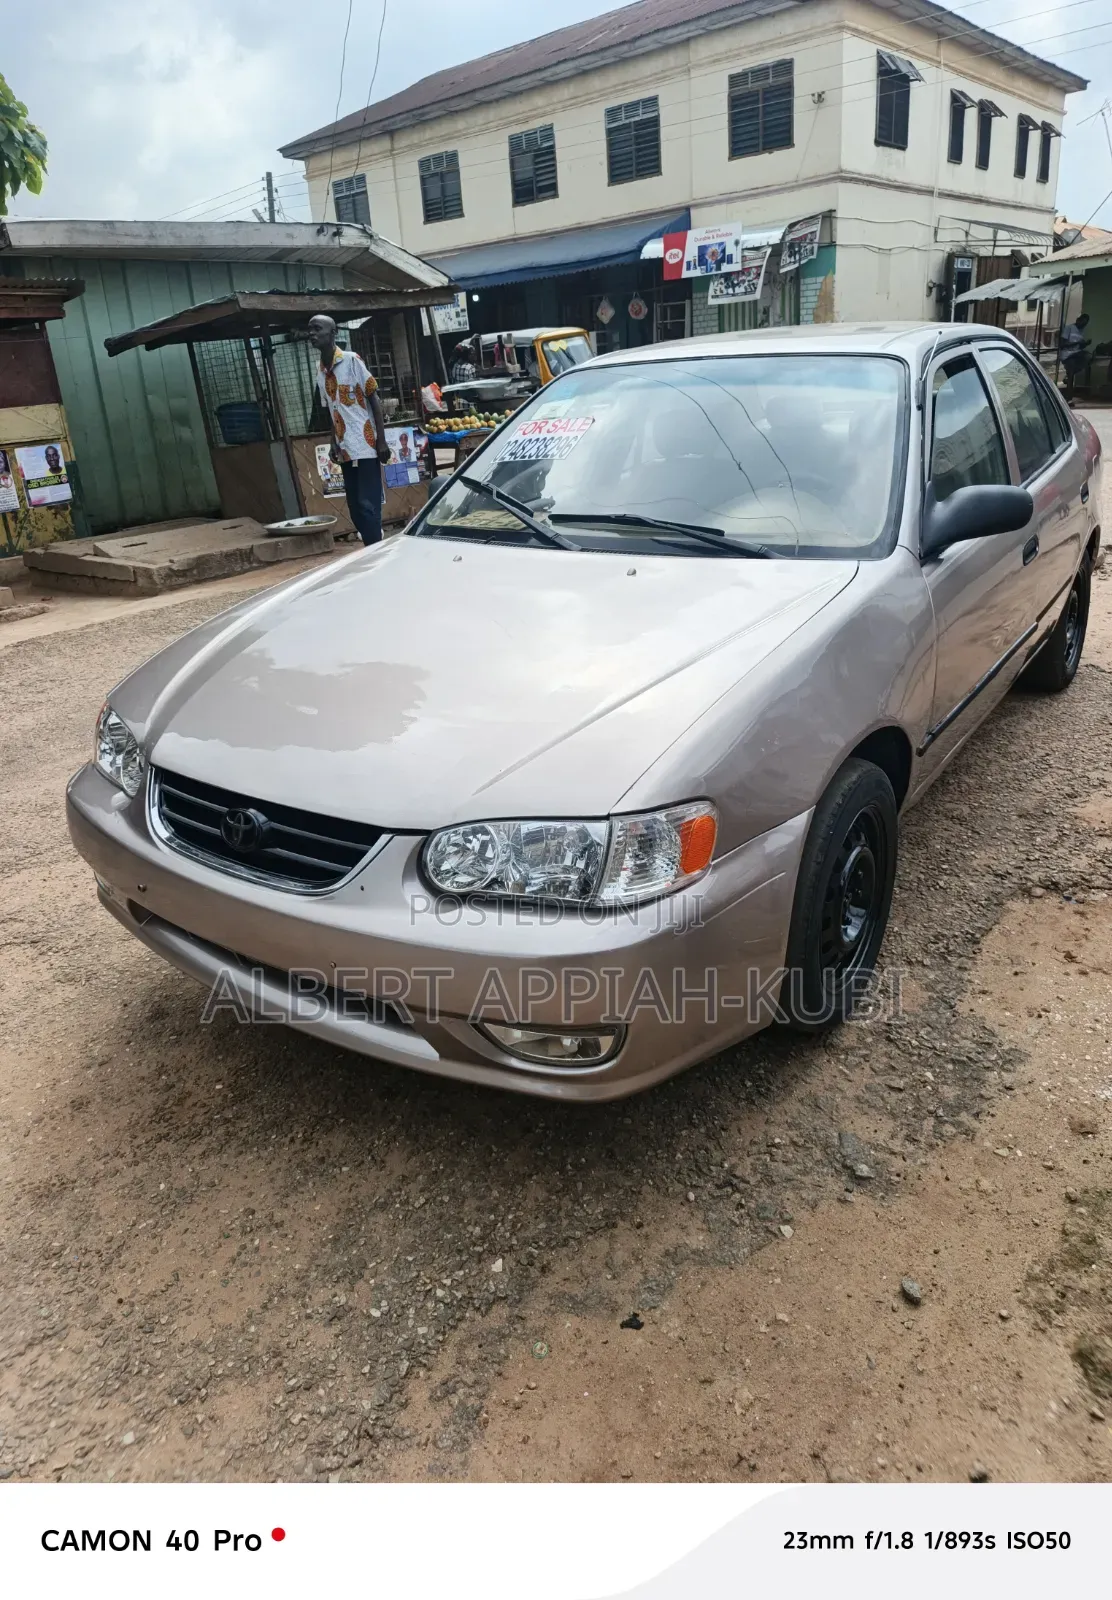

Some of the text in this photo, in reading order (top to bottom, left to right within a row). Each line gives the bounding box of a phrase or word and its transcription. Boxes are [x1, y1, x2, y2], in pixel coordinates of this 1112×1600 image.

[694, 235, 711, 243] Durable
[716, 231, 733, 239] Reliable
[668, 251, 680, 261] itel
[516, 417, 592, 436] FOR SALE
